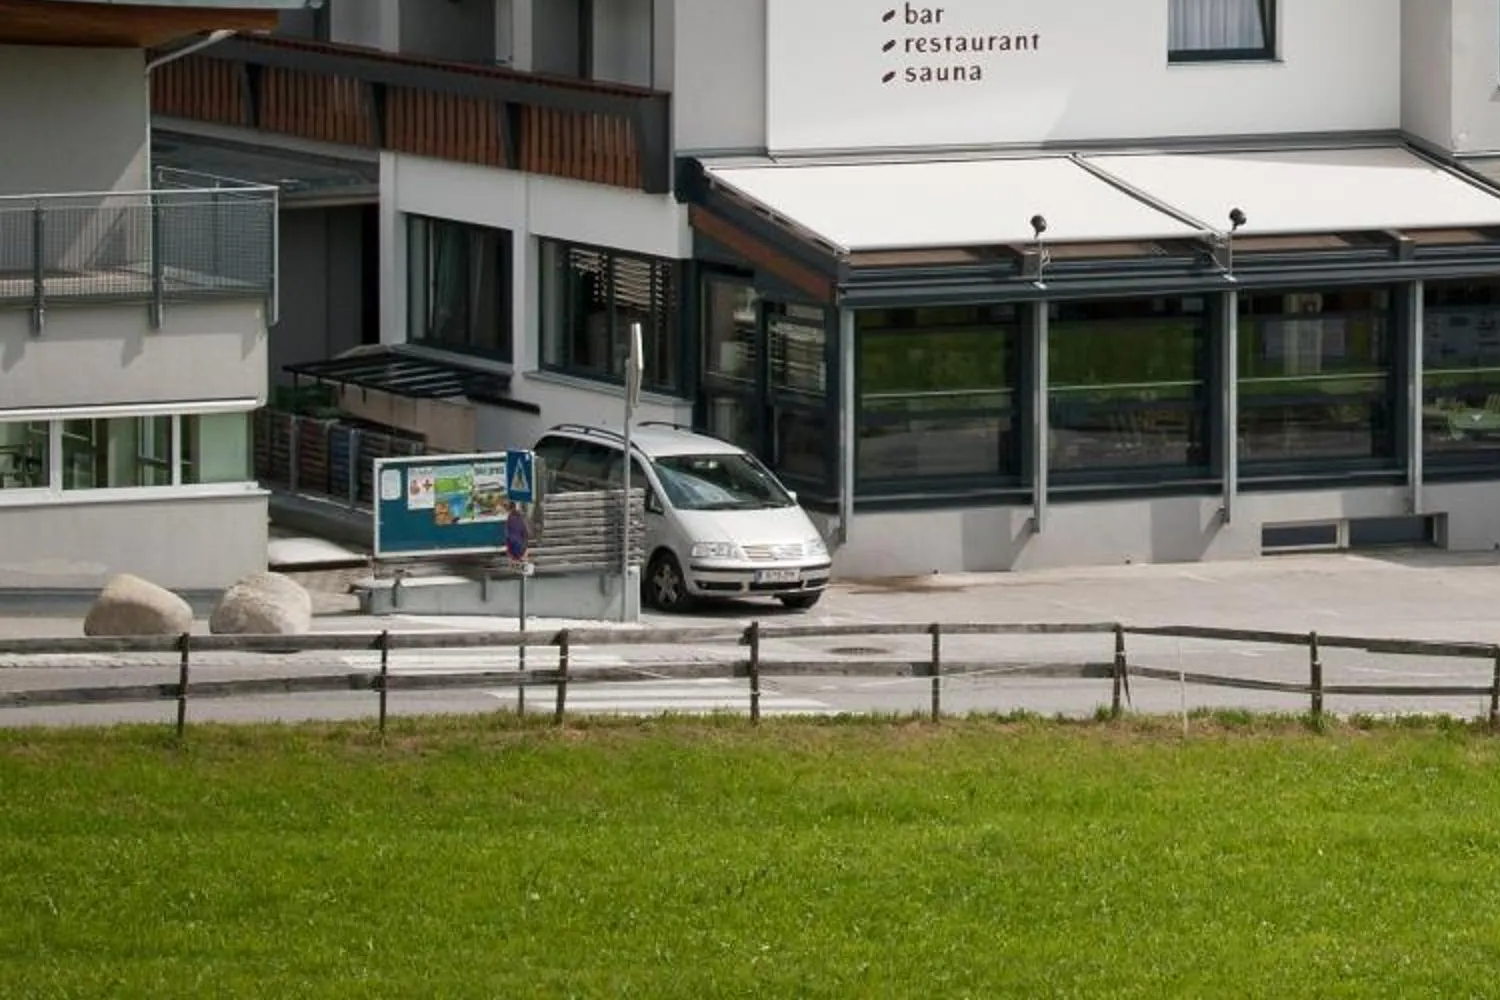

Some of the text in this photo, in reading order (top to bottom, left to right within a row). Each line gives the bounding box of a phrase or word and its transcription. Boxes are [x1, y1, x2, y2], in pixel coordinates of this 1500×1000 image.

[904, 2, 945, 25] bar
[904, 33, 1040, 53] restaurant
[904, 65, 982, 83] sauna
